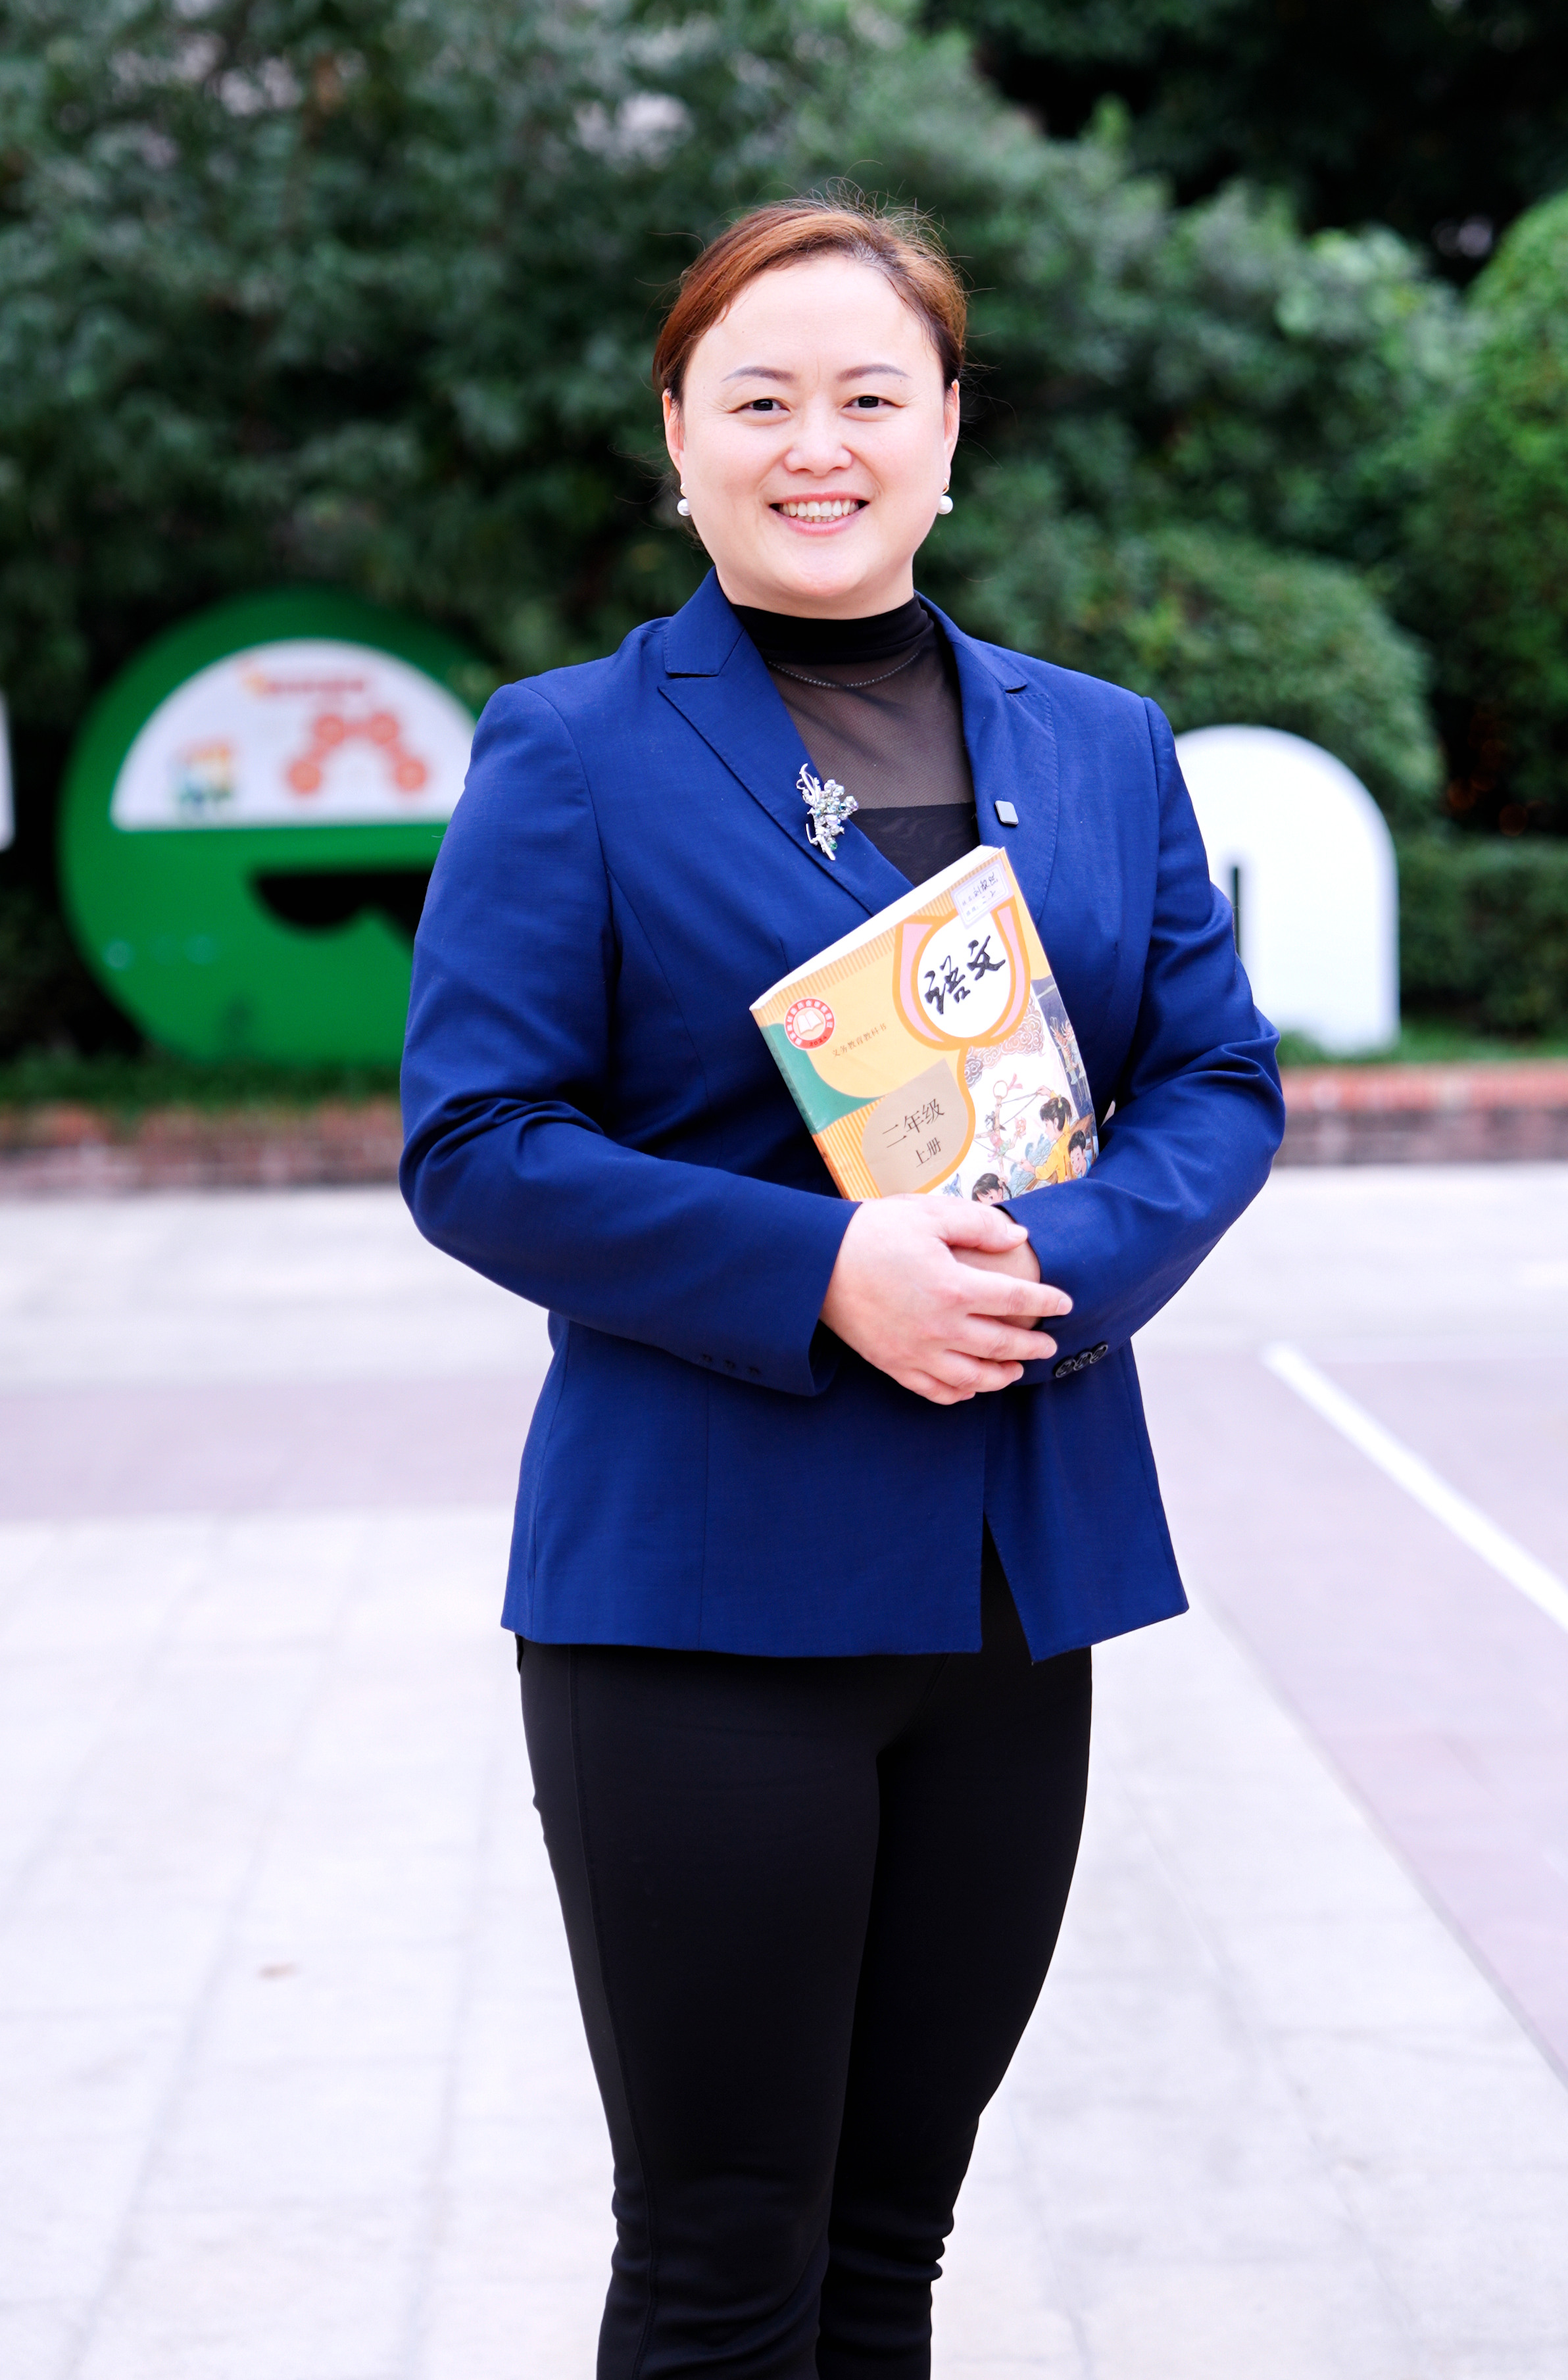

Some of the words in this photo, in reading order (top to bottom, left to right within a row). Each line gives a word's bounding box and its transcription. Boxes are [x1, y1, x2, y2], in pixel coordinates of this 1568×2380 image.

[923, 935, 1006, 1015] 语文
[809, 1035, 827, 1047] 2024
[882, 1098, 945, 1148] 二年级
[916, 1137, 941, 1167] 上册
